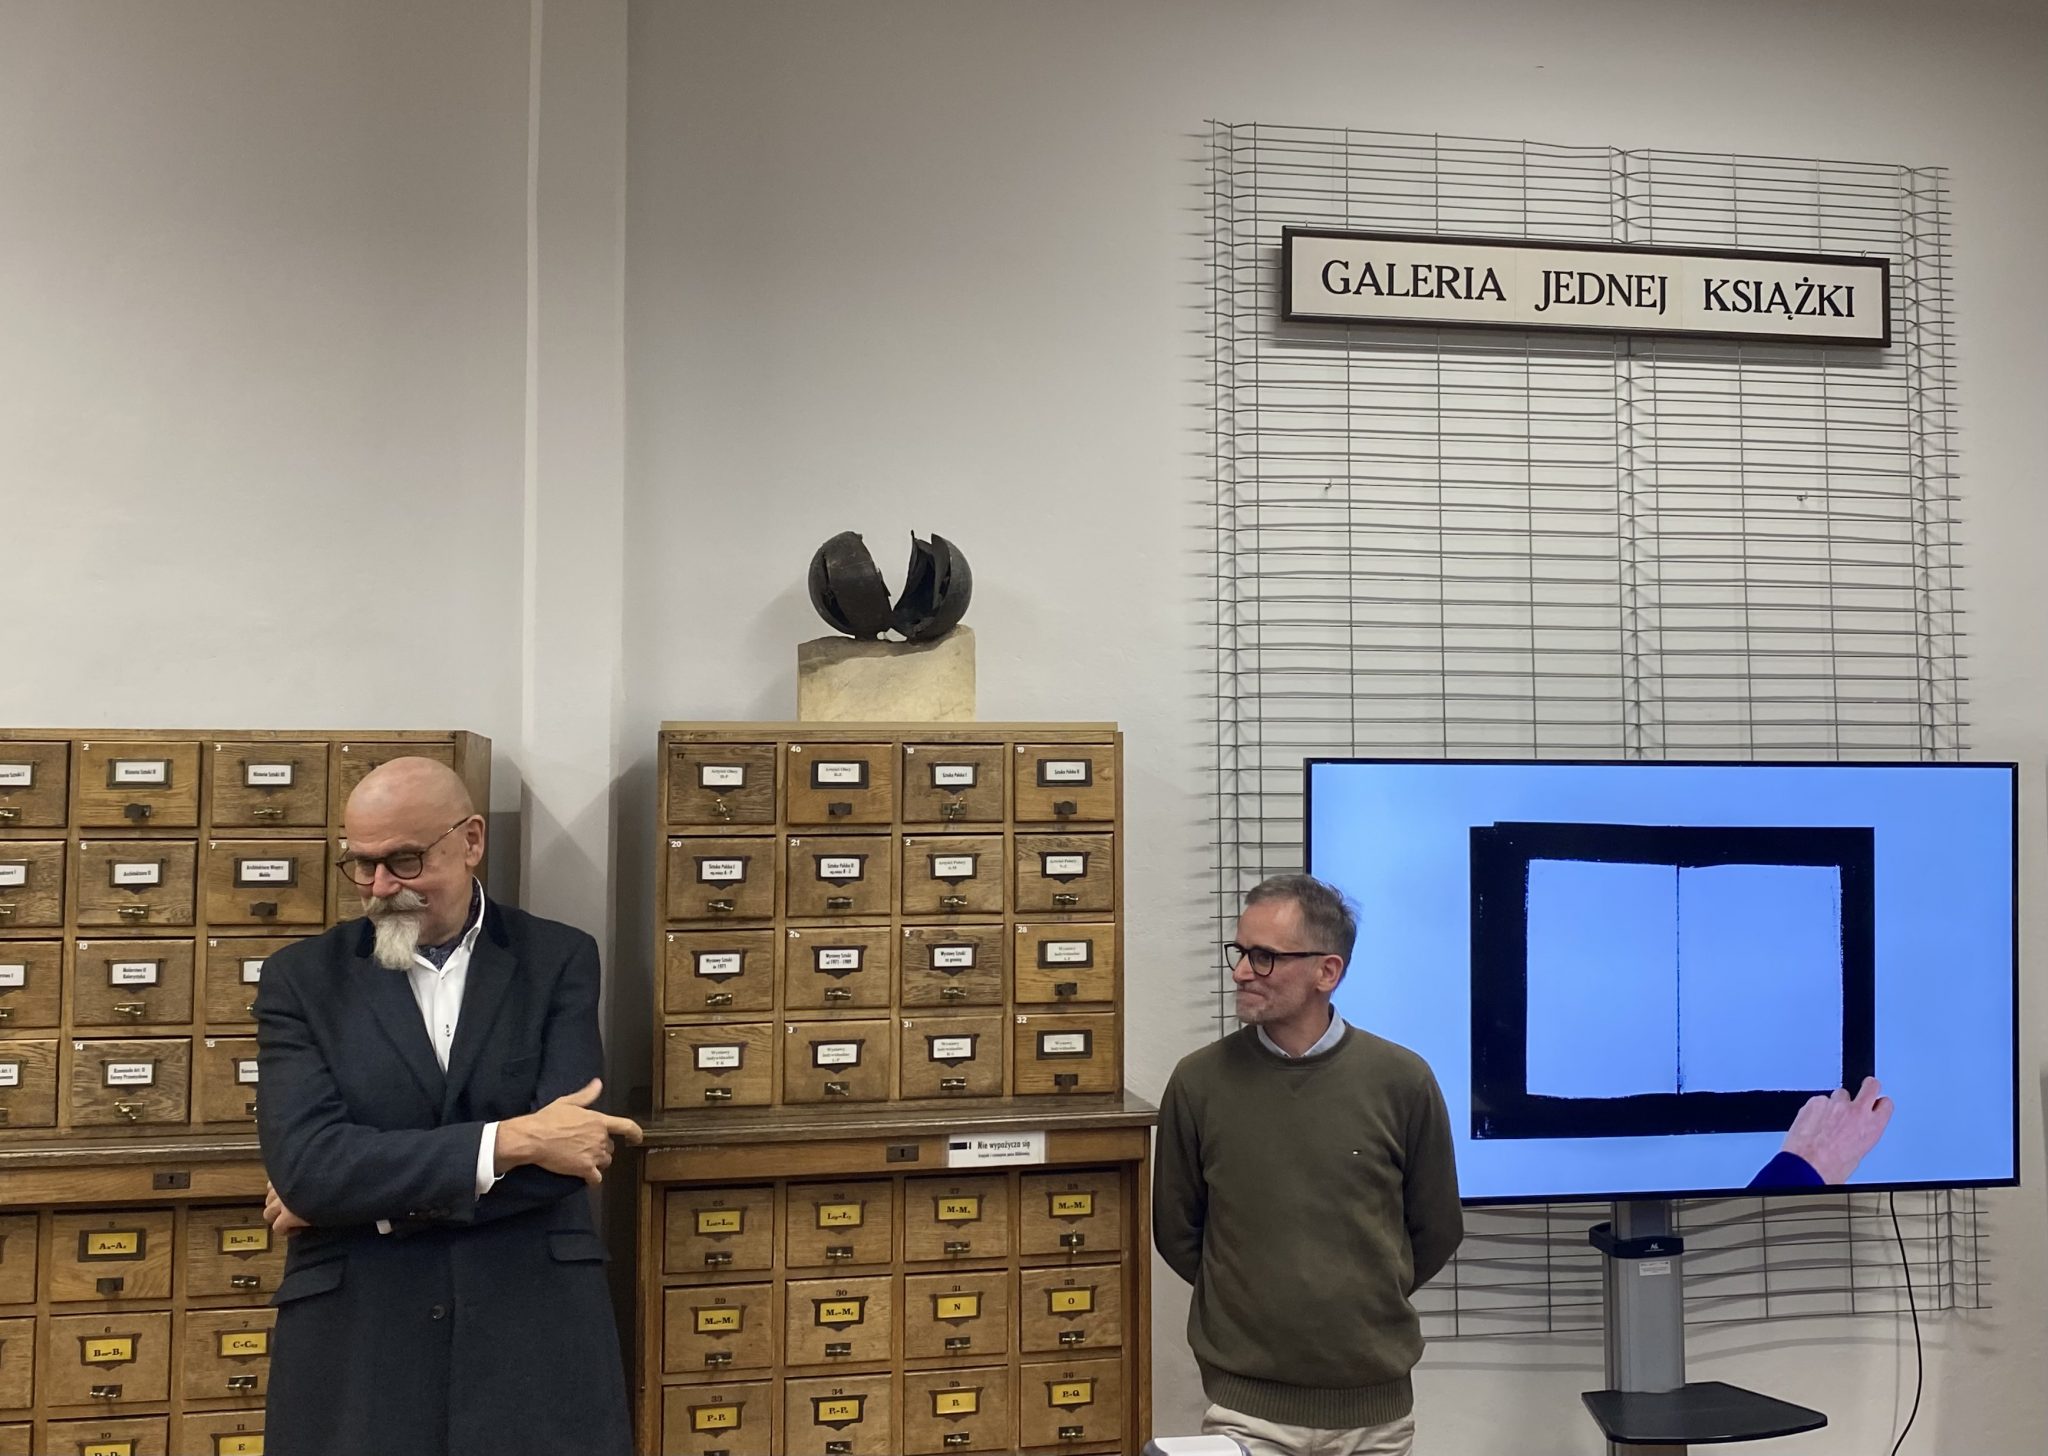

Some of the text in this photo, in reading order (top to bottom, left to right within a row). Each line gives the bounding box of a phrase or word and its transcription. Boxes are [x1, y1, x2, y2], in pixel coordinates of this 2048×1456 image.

[1321, 258, 1856, 322] GALERIA JEDNEJ KSIĄŻKI
[83, 743, 90, 751] 2
[81, 842, 87, 850] 6
[1016, 1016, 1027, 1024] 32
[977, 1140, 1031, 1151] Nie wypożycza się
[953, 1303, 961, 1311] N
[238, 1443, 245, 1451] E
